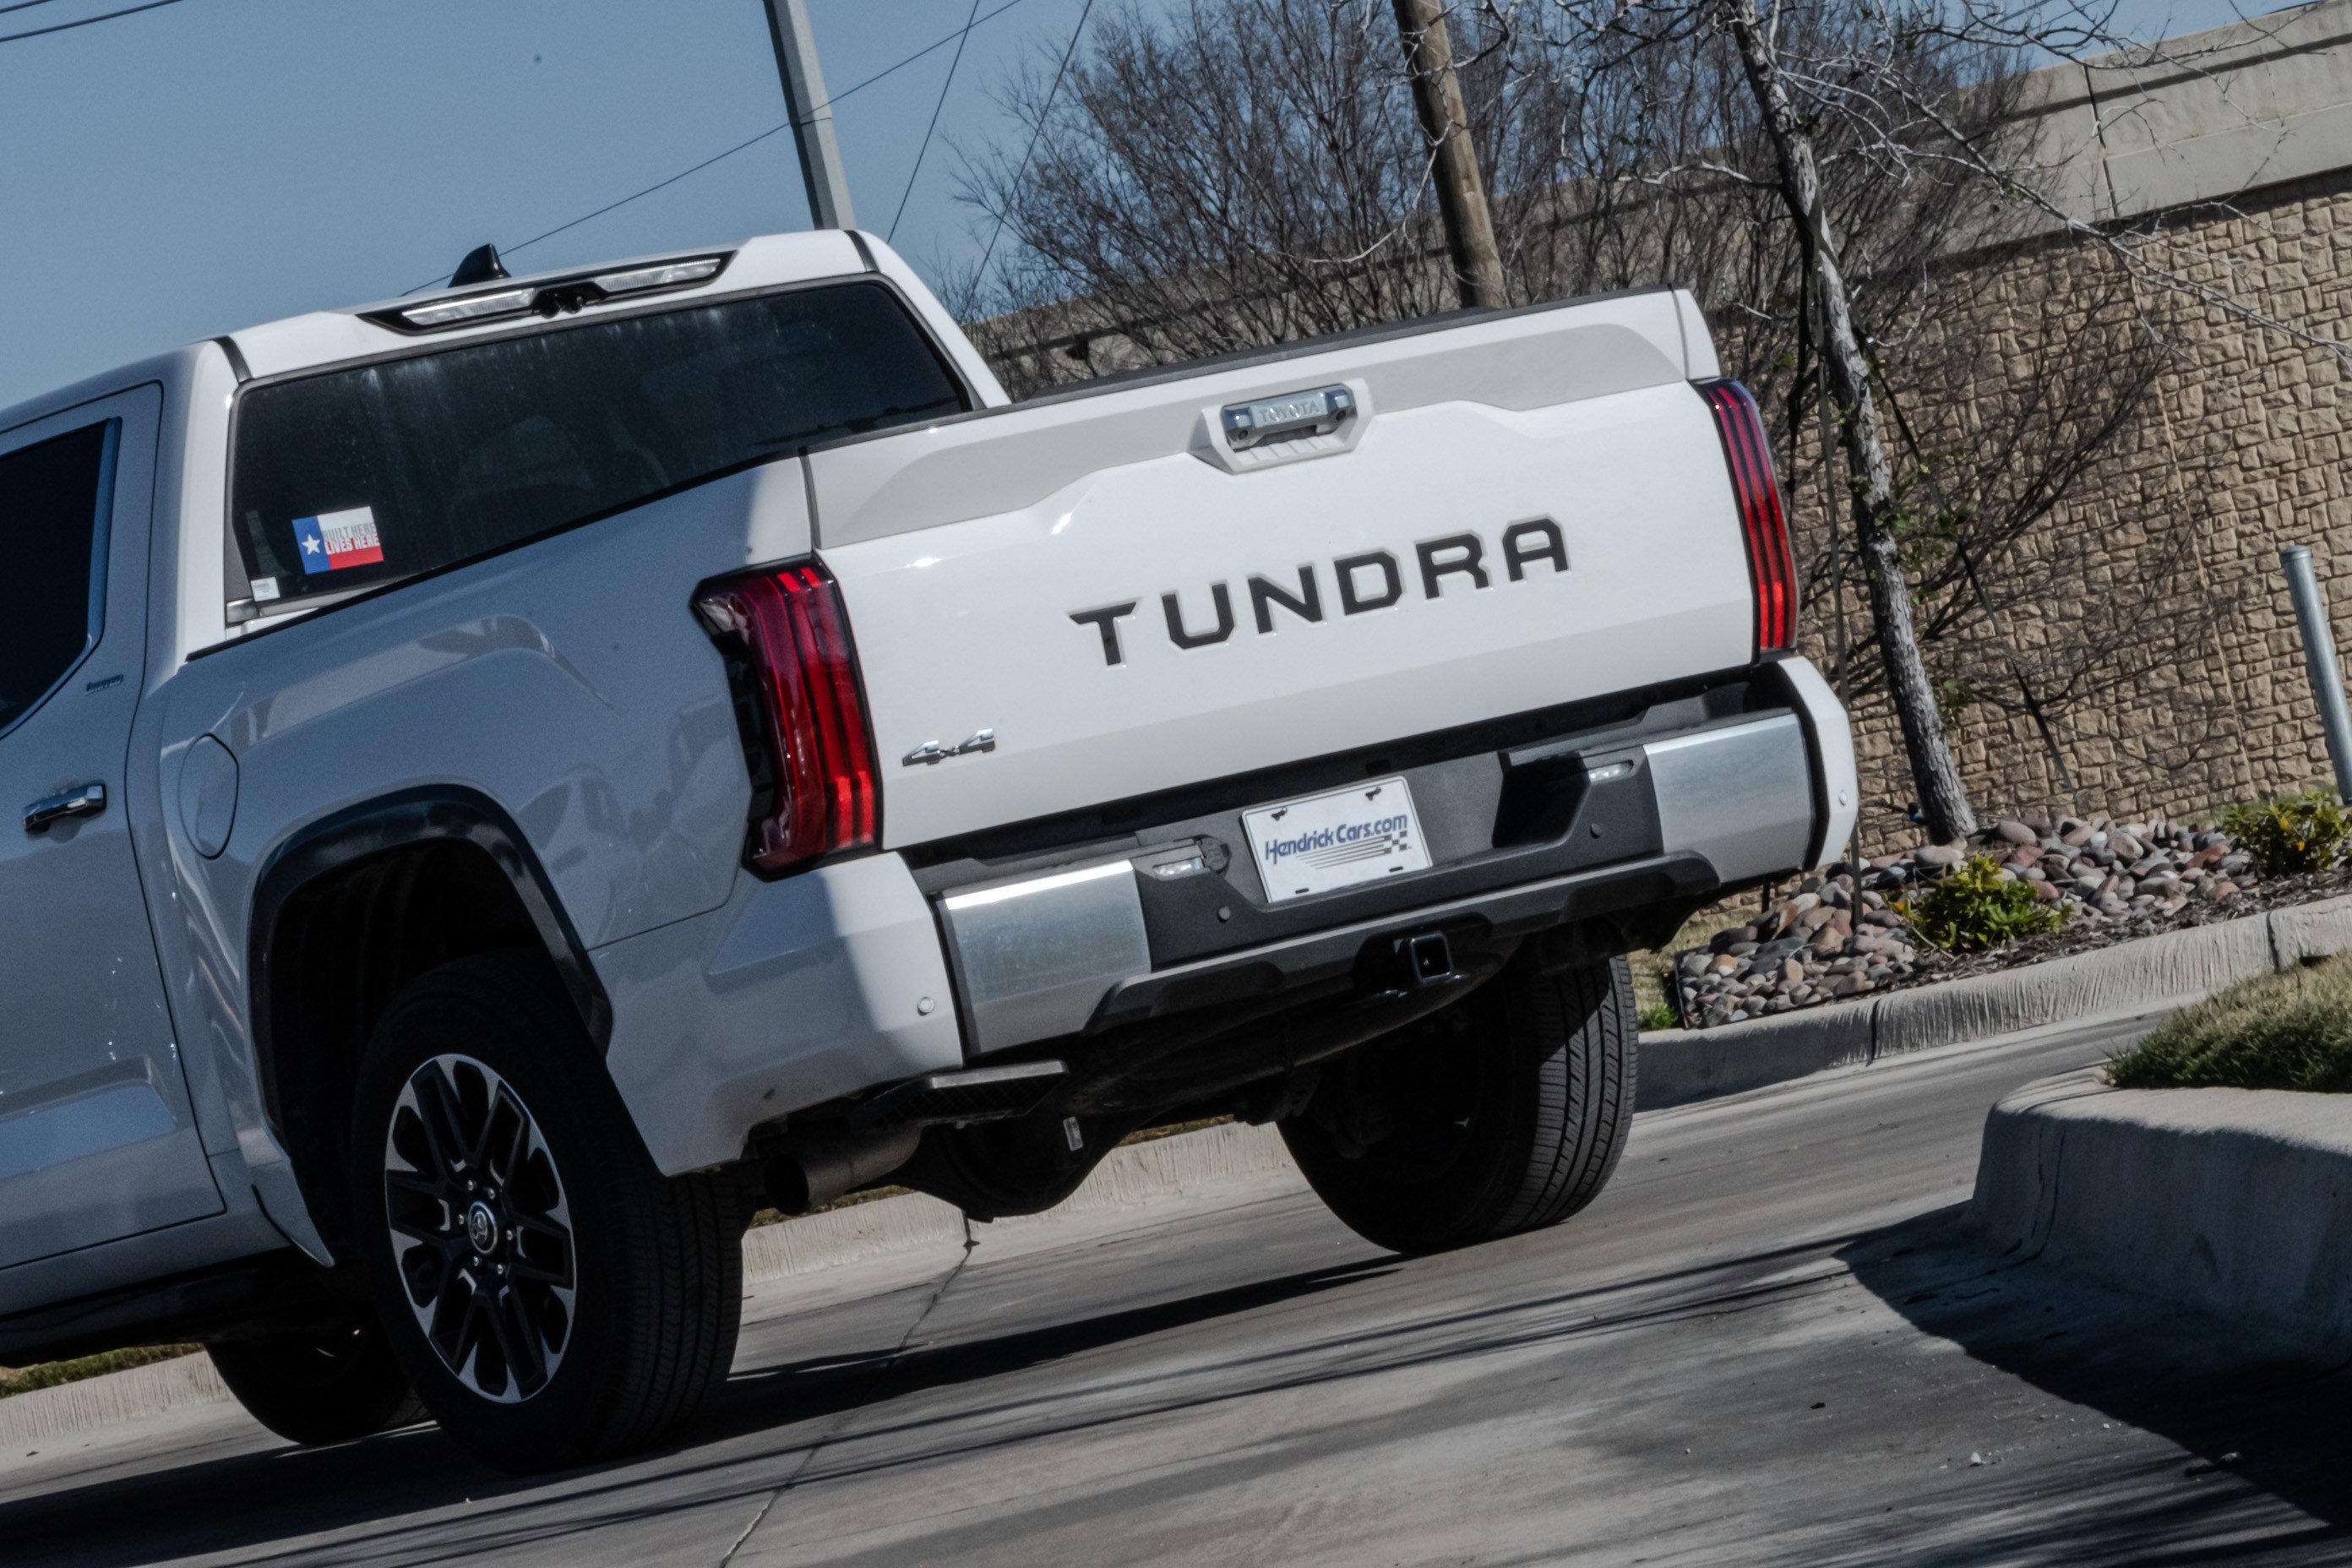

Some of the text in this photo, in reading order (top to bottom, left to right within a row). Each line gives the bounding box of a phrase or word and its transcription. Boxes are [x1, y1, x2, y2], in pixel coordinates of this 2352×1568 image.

[1259, 400, 1320, 423] TOYOTA
[323, 522, 378, 542] BUILT HERE
[325, 535, 380, 555] LIVES HERE
[1069, 516, 1570, 667] TUNDRA
